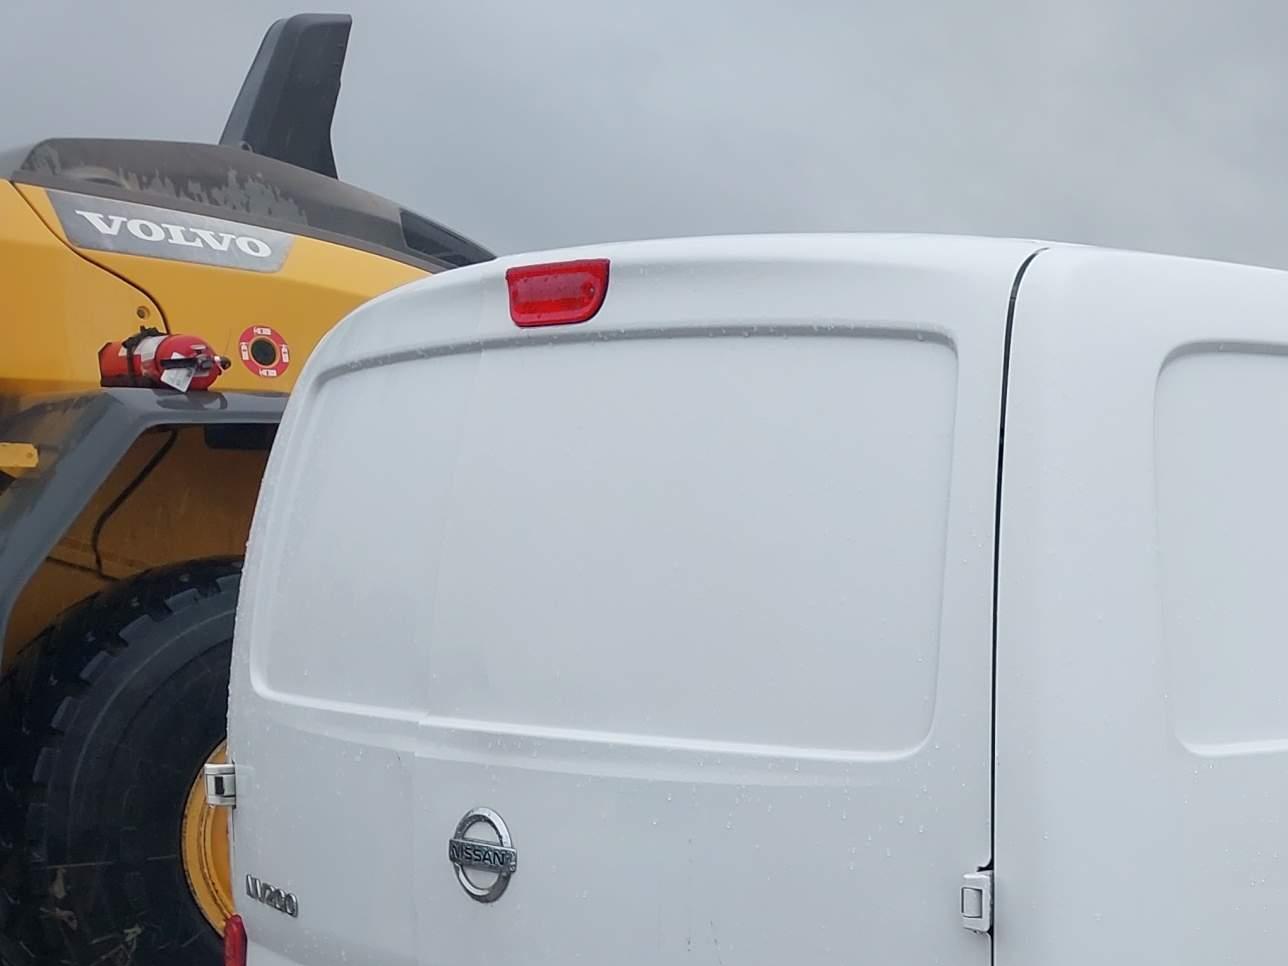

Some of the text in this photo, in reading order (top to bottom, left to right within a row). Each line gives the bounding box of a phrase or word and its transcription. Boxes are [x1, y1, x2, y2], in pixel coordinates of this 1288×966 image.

[74, 209, 273, 258] VOLVO
[450, 844, 506, 866] NISSAN
[246, 874, 299, 918] NV200
